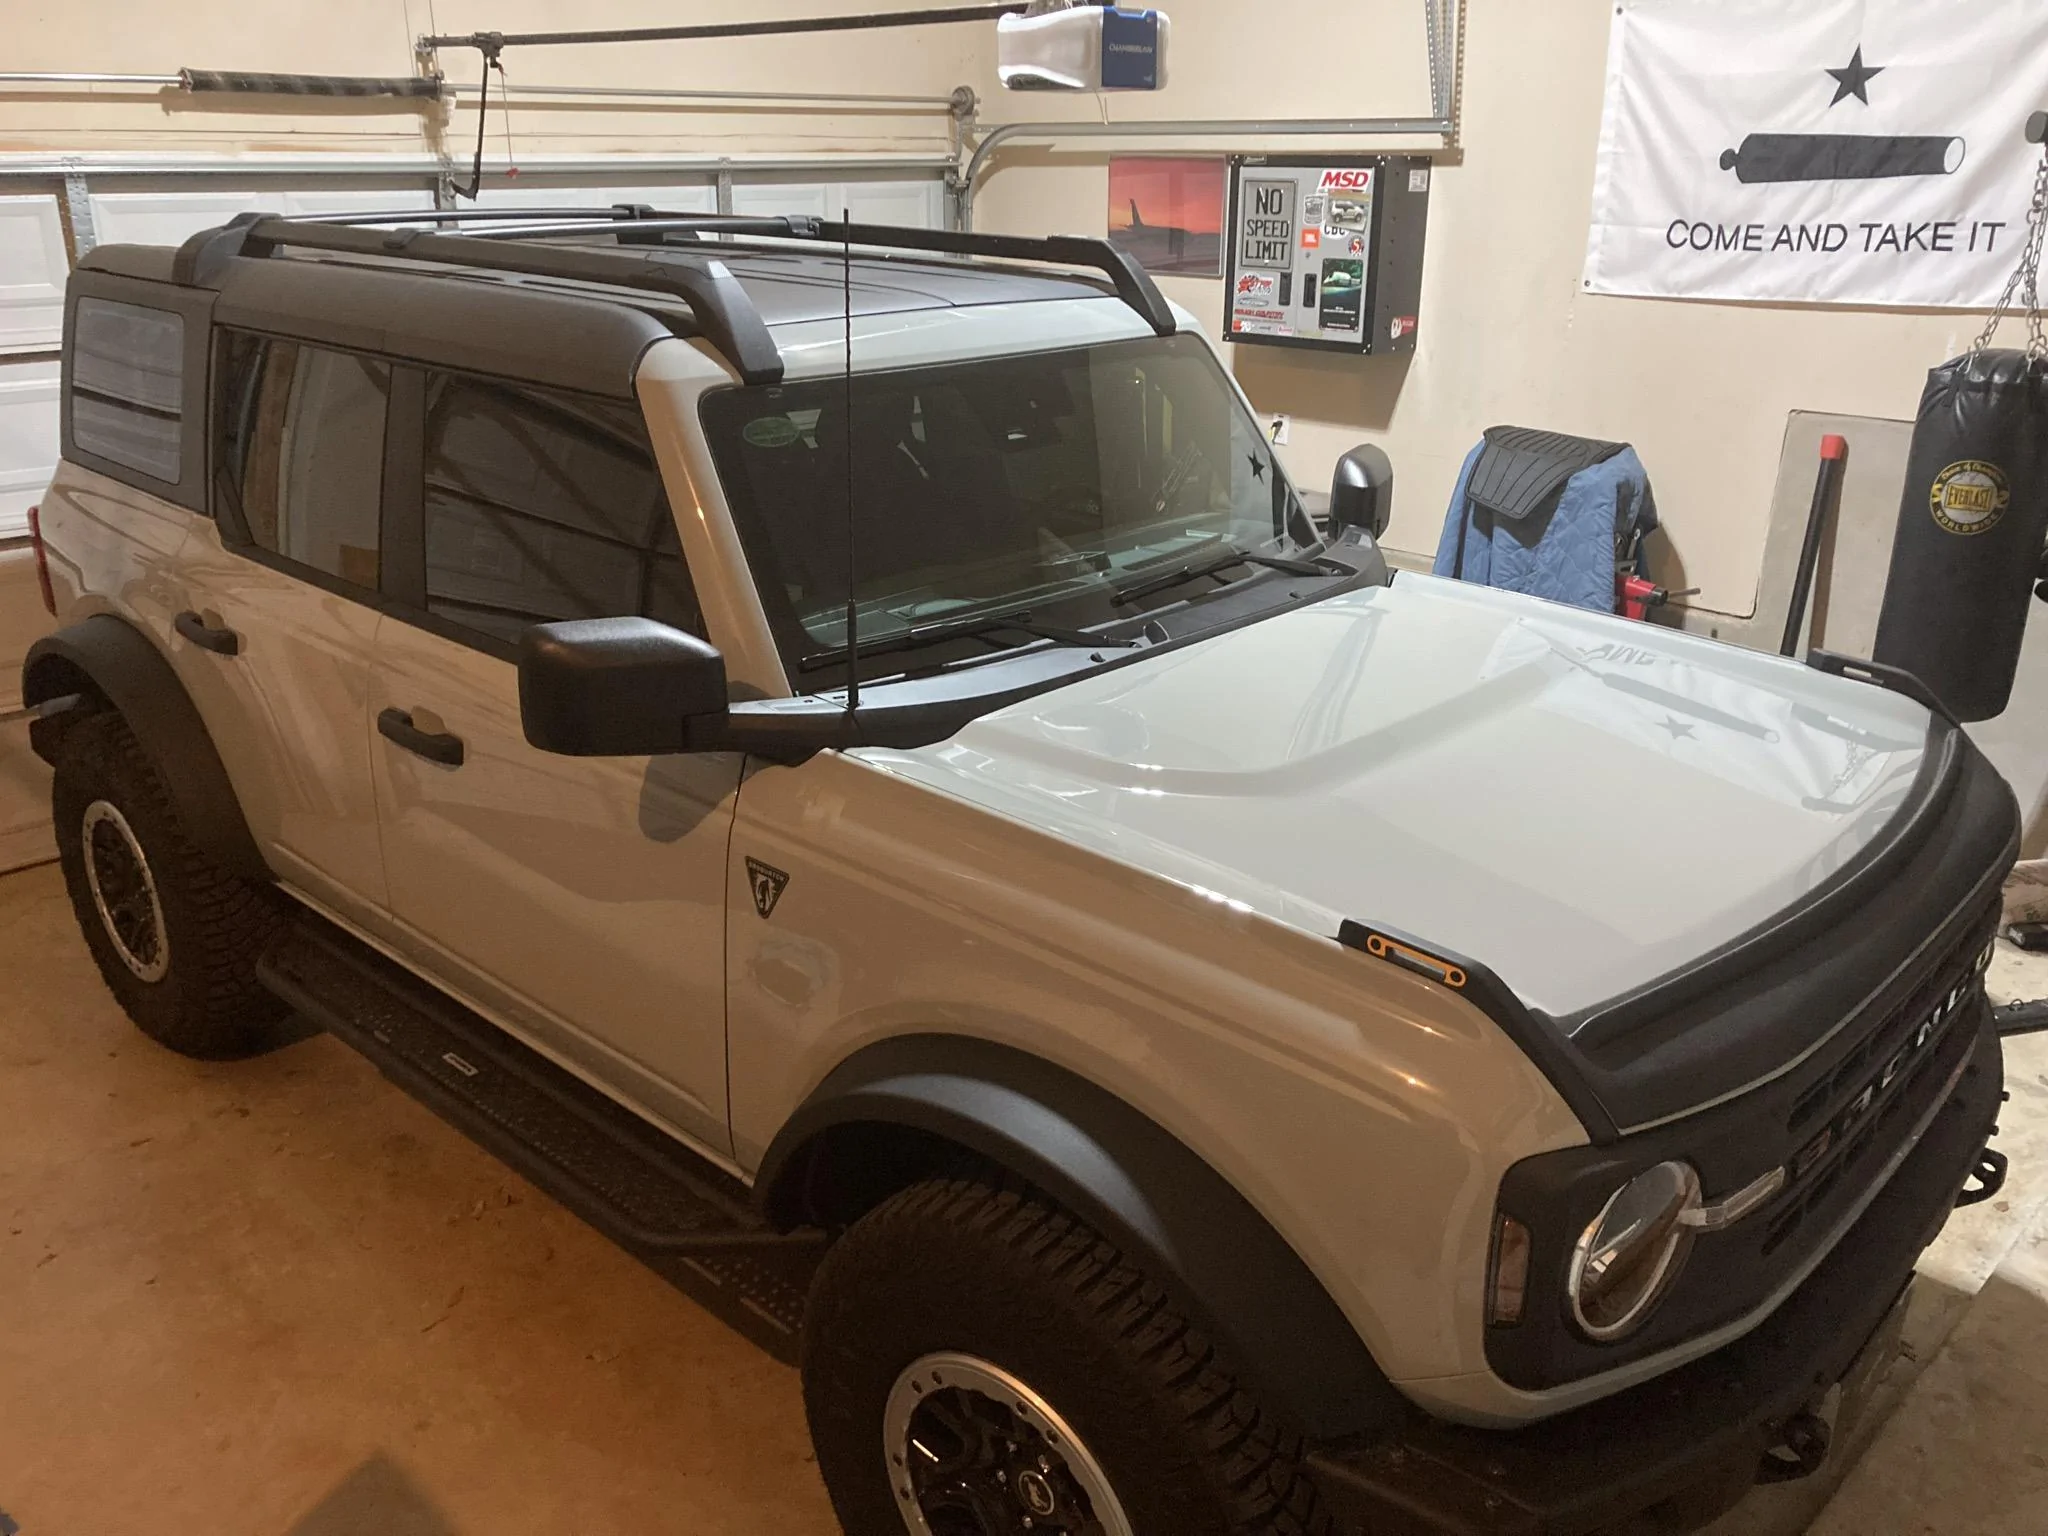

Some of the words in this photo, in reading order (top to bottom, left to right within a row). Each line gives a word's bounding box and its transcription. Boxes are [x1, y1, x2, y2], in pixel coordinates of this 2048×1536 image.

[1321, 171, 1369, 188] MSD
[1255, 187, 1284, 215] NO
[1246, 218, 1290, 239] SPEED
[1666, 218, 1765, 253] COME
[1771, 223, 1848, 253] AND
[1858, 221, 1957, 253] TAKE
[1967, 221, 2007, 253] IT
[1245, 240, 1289, 261] LIMIT
[1947, 486, 1990, 508] EVERLAST
